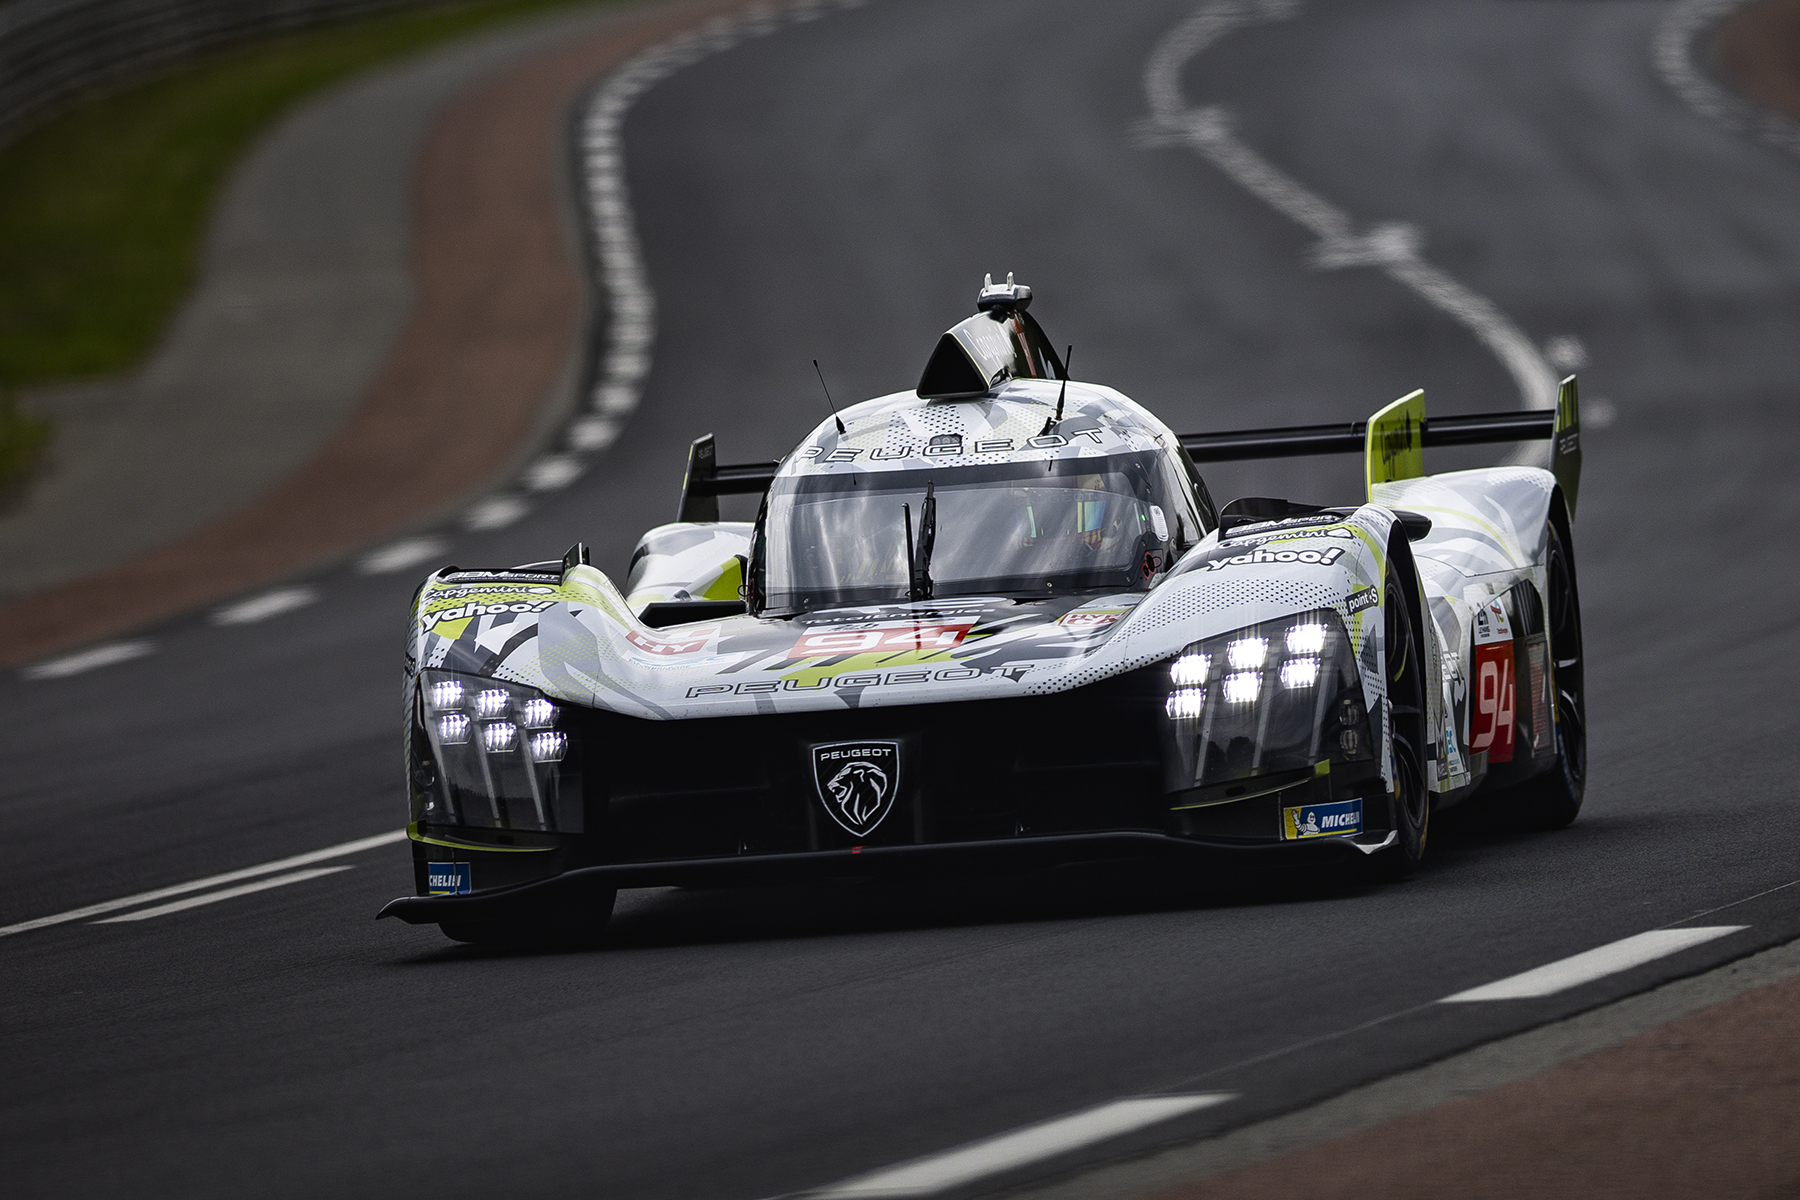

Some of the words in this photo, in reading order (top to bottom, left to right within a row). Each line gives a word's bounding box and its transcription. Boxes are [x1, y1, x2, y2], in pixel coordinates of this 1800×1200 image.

[797, 428, 1104, 463] PEUGEOT
[1219, 529, 1326, 549] Capgemini
[1206, 547, 1345, 572] yahoo!
[422, 586, 526, 601] Capgemini
[1348, 592, 1370, 613] point
[421, 601, 555, 632] yahoo!
[802, 627, 959, 654] 94
[685, 664, 1034, 698] PEUGEOT
[1472, 658, 1514, 748] 94
[820, 748, 892, 762] PEUGEOT
